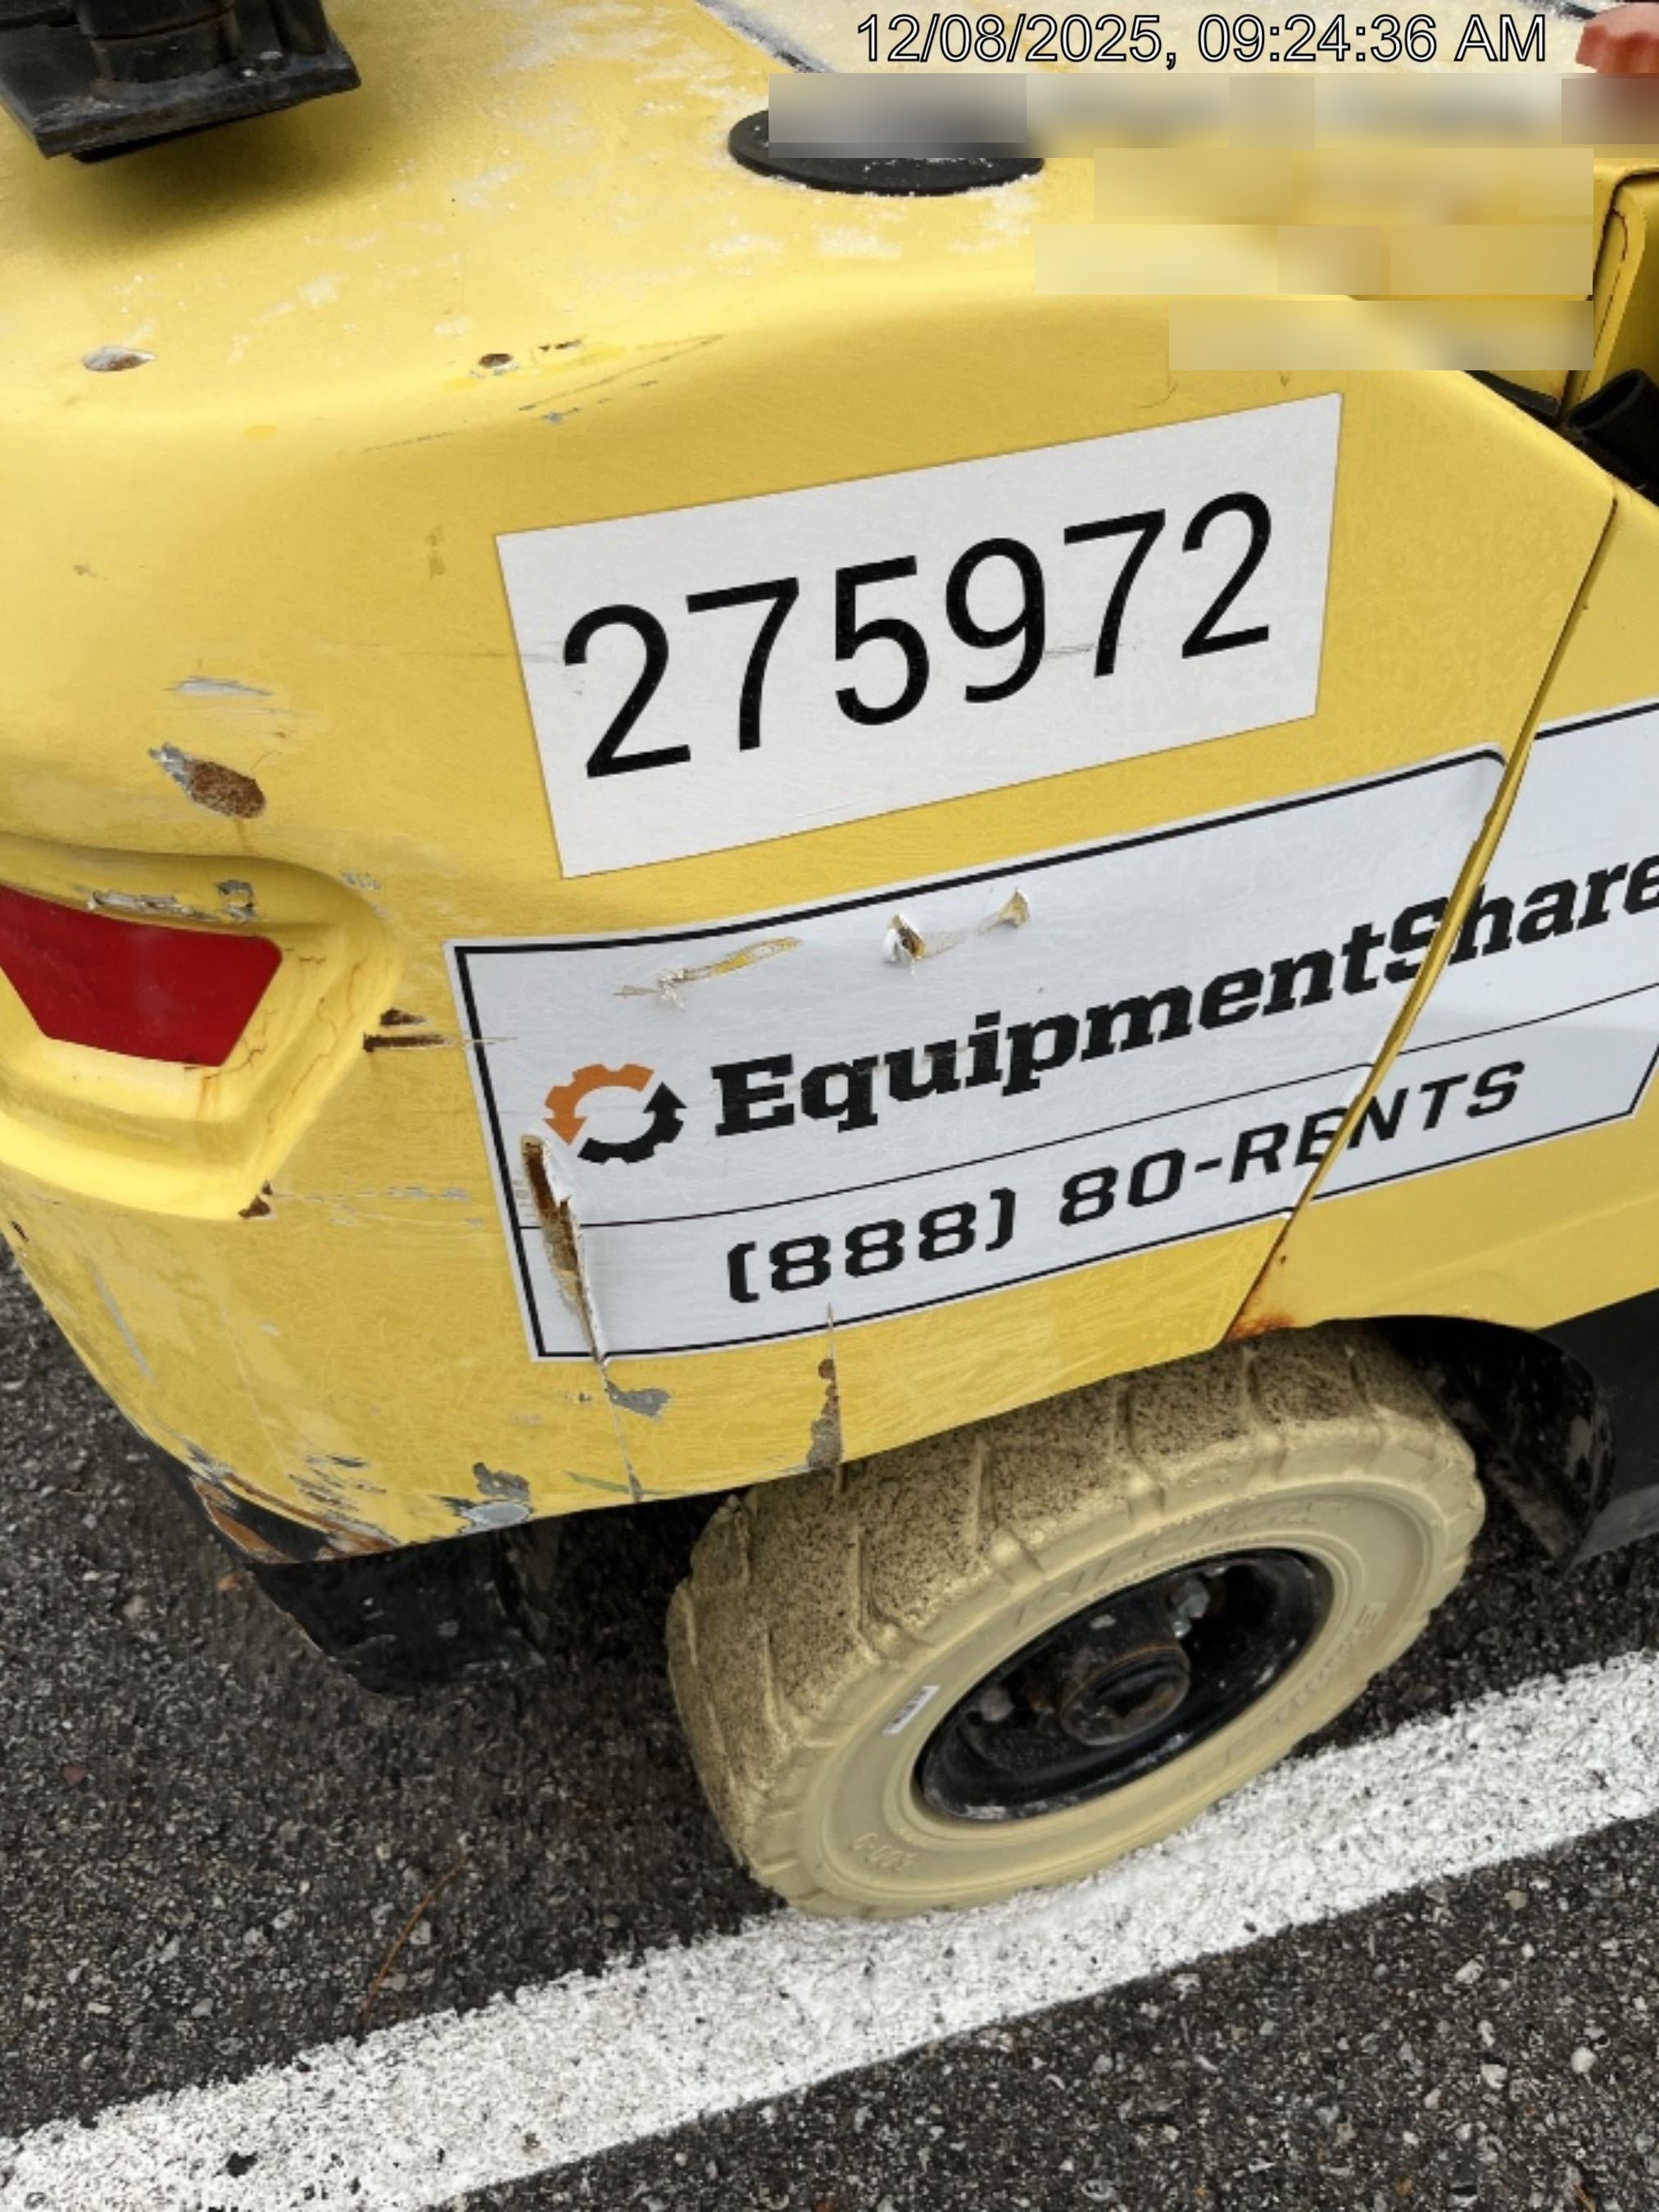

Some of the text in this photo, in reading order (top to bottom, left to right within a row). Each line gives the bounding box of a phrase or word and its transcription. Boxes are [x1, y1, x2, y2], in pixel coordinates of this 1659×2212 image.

[564, 492, 1271, 778] 275972
[710, 854, 1659, 1136] EquipmentShare
[728, 1061, 1525, 1303] (888) 80-RENTS
